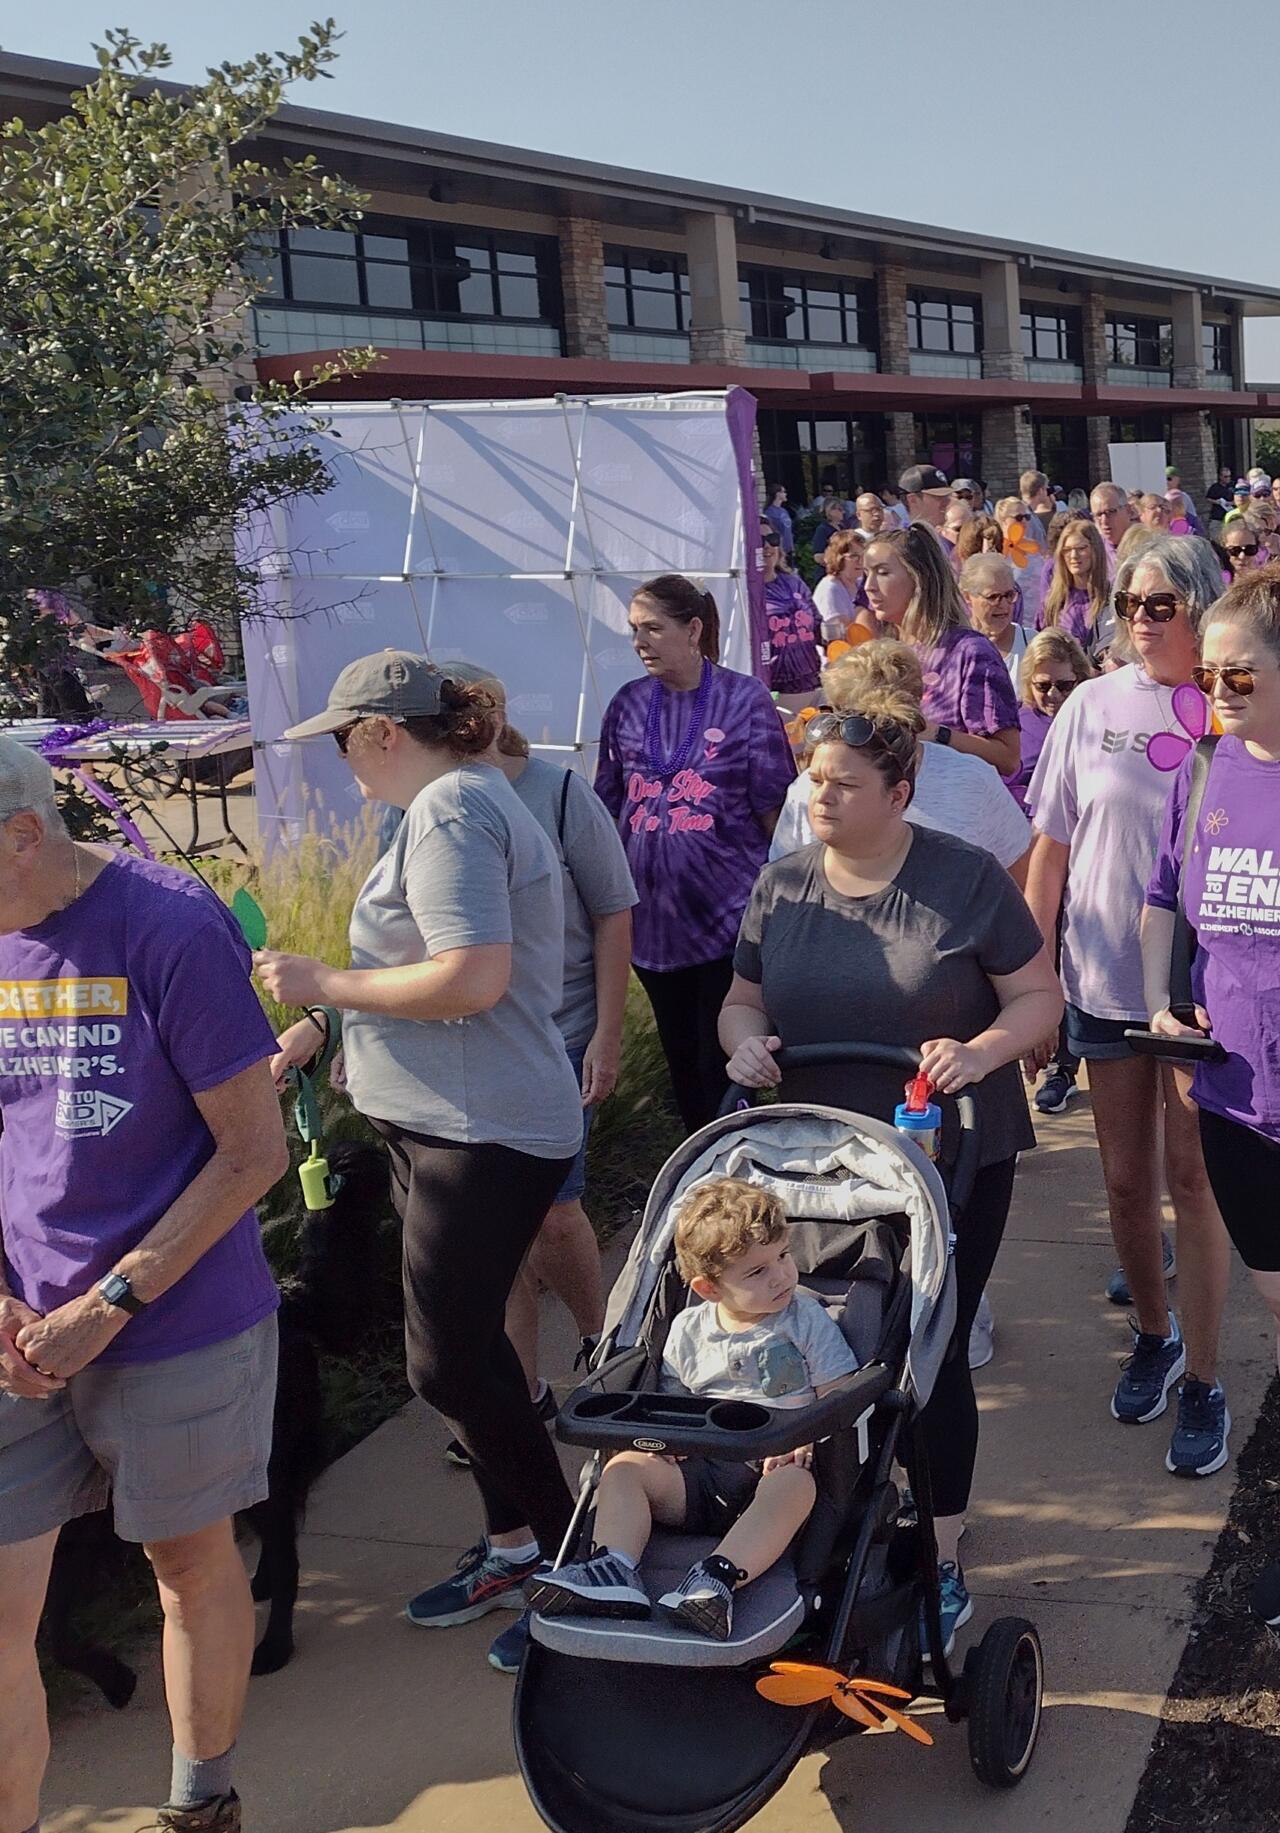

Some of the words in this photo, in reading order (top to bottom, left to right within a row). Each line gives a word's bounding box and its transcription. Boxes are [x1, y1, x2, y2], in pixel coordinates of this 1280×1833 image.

[628, 772, 663, 802] One
[667, 768, 717, 805] Step
[667, 806, 714, 835] Time
[1205, 882, 1223, 893] TO
[1200, 923, 1239, 934] ALZHEIMER'S
[0, 1027, 17, 1049] E
[20, 1026, 64, 1048] CAN
[66, 1024, 122, 1047] END
[0, 1054, 126, 1079] LZHEIMER'S.
[73, 1090, 95, 1104] TO
